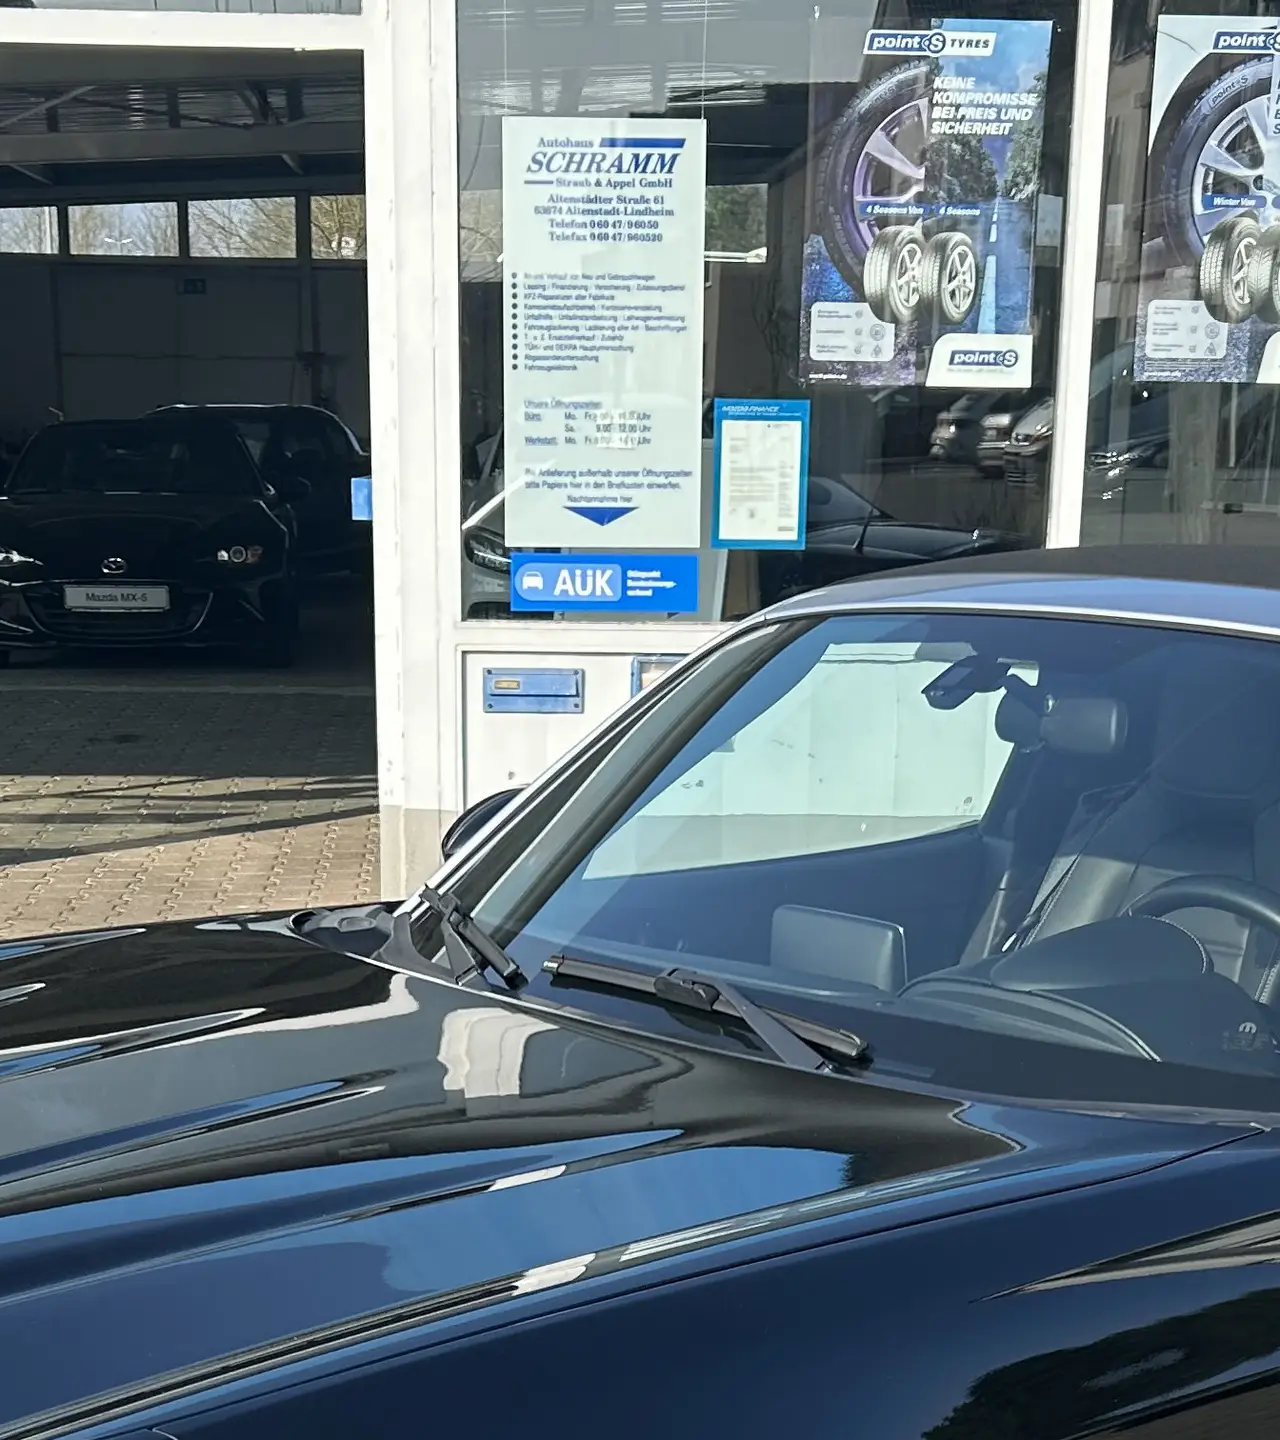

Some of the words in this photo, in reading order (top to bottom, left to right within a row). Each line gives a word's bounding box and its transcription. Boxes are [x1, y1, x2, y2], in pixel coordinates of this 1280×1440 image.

[873, 33, 920, 50] point
[950, 38, 990, 48] TYRES
[1218, 33, 1266, 48] point
[933, 76, 976, 89] KEINE
[932, 91, 1037, 106] KOMPROMISSE
[931, 107, 954, 119] BEI
[957, 107, 997, 120] PREIS
[1000, 108, 1033, 121] UND
[931, 122, 1013, 135] SICHERHEIT
[537, 137, 594, 148] Autohaus
[526, 151, 681, 174] SCHRAMM
[555, 178, 591, 188] Straub
[594, 178, 602, 187] &
[605, 178, 635, 190] Appel
[639, 178, 673, 188] GmbH
[547, 194, 614, 205] Altenstädter
[616, 195, 651, 205] Straße
[653, 195, 665, 205] 61
[1213, 196, 1240, 206] Winter
[565, 206, 675, 216] Altenstadt-Lindheim
[873, 206, 907, 214] Seasons
[946, 207, 980, 216] Seasons
[548, 219, 587, 229] Telefon
[548, 232, 587, 242] Telefax
[953, 352, 996, 364] point
[553, 568, 614, 597] AÜK
[85, 592, 118, 603] Mazda
